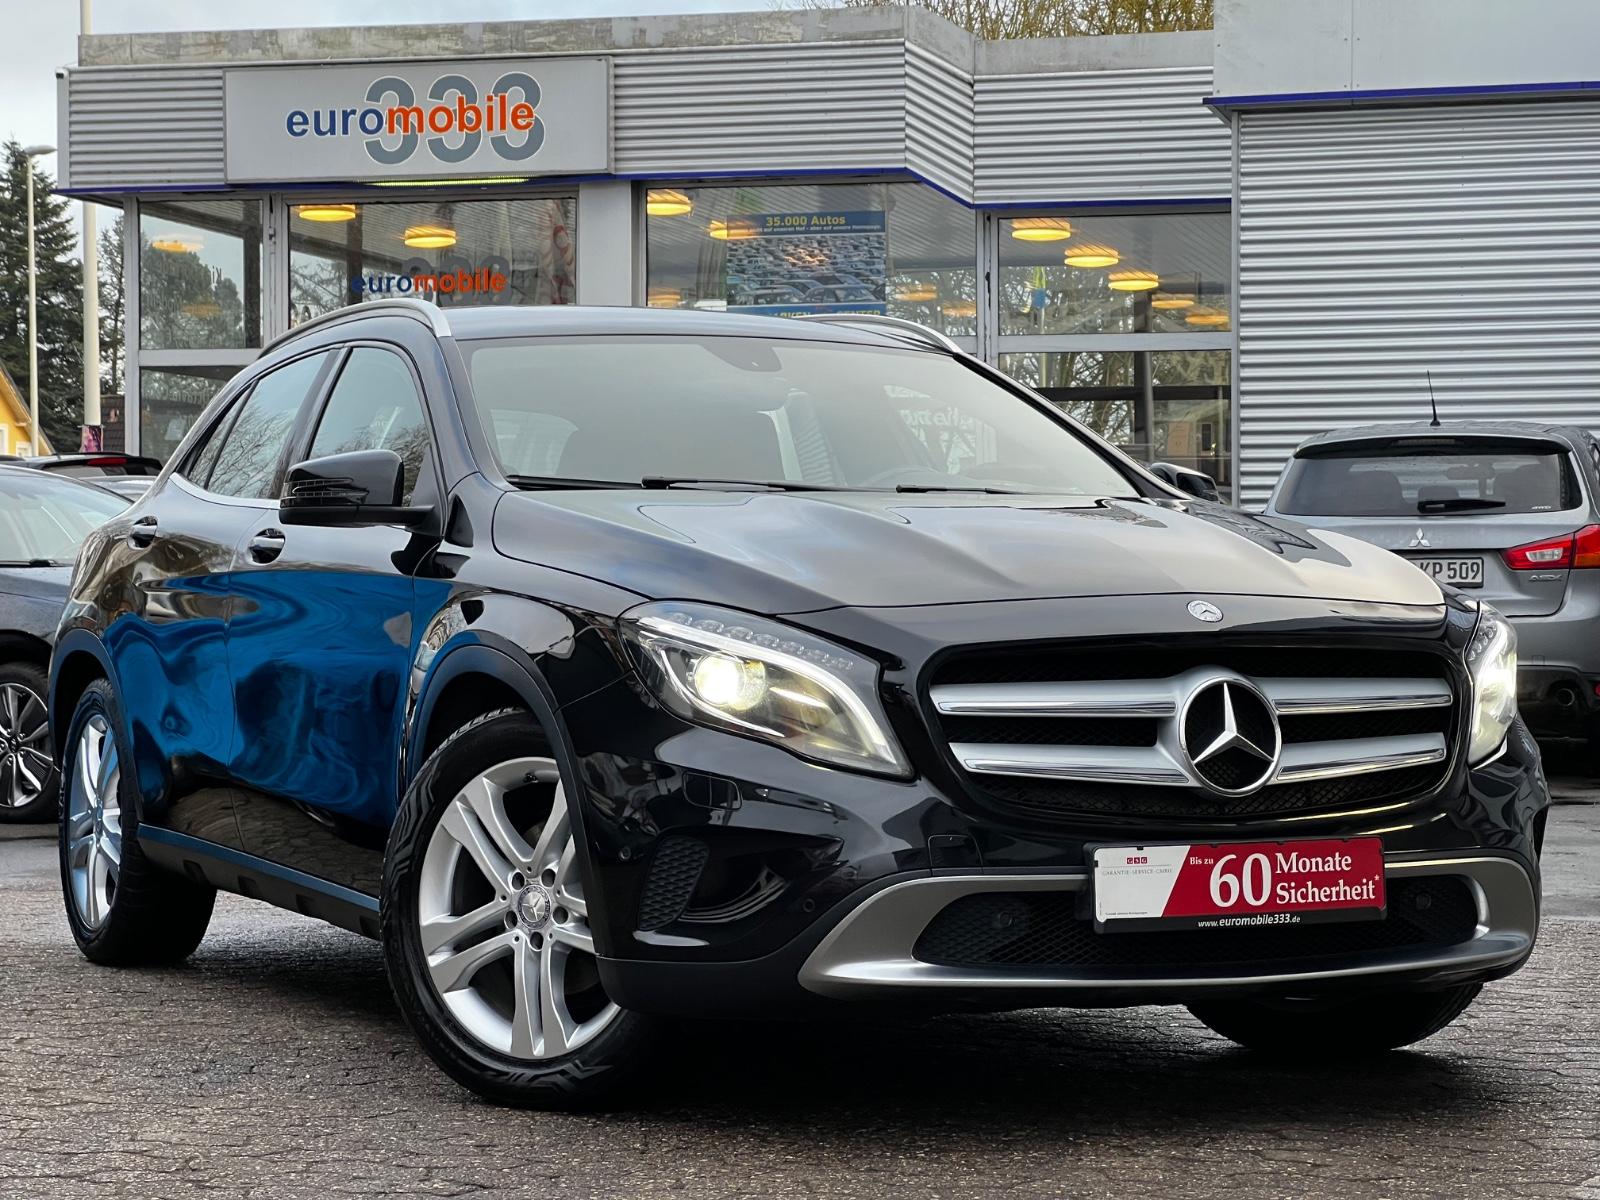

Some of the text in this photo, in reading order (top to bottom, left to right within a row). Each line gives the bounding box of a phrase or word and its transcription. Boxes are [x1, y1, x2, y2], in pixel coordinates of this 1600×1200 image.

[286, 93, 535, 137] euromobile
[364, 71, 545, 165] 333
[766, 215, 846, 226] 35.000 Autos
[351, 267, 508, 293] euromobile
[1447, 561, 1480, 580] 509
[1190, 852, 1352, 907] Bis zu 60 Monate
[1198, 913, 1301, 927] www.euromobile333.de
